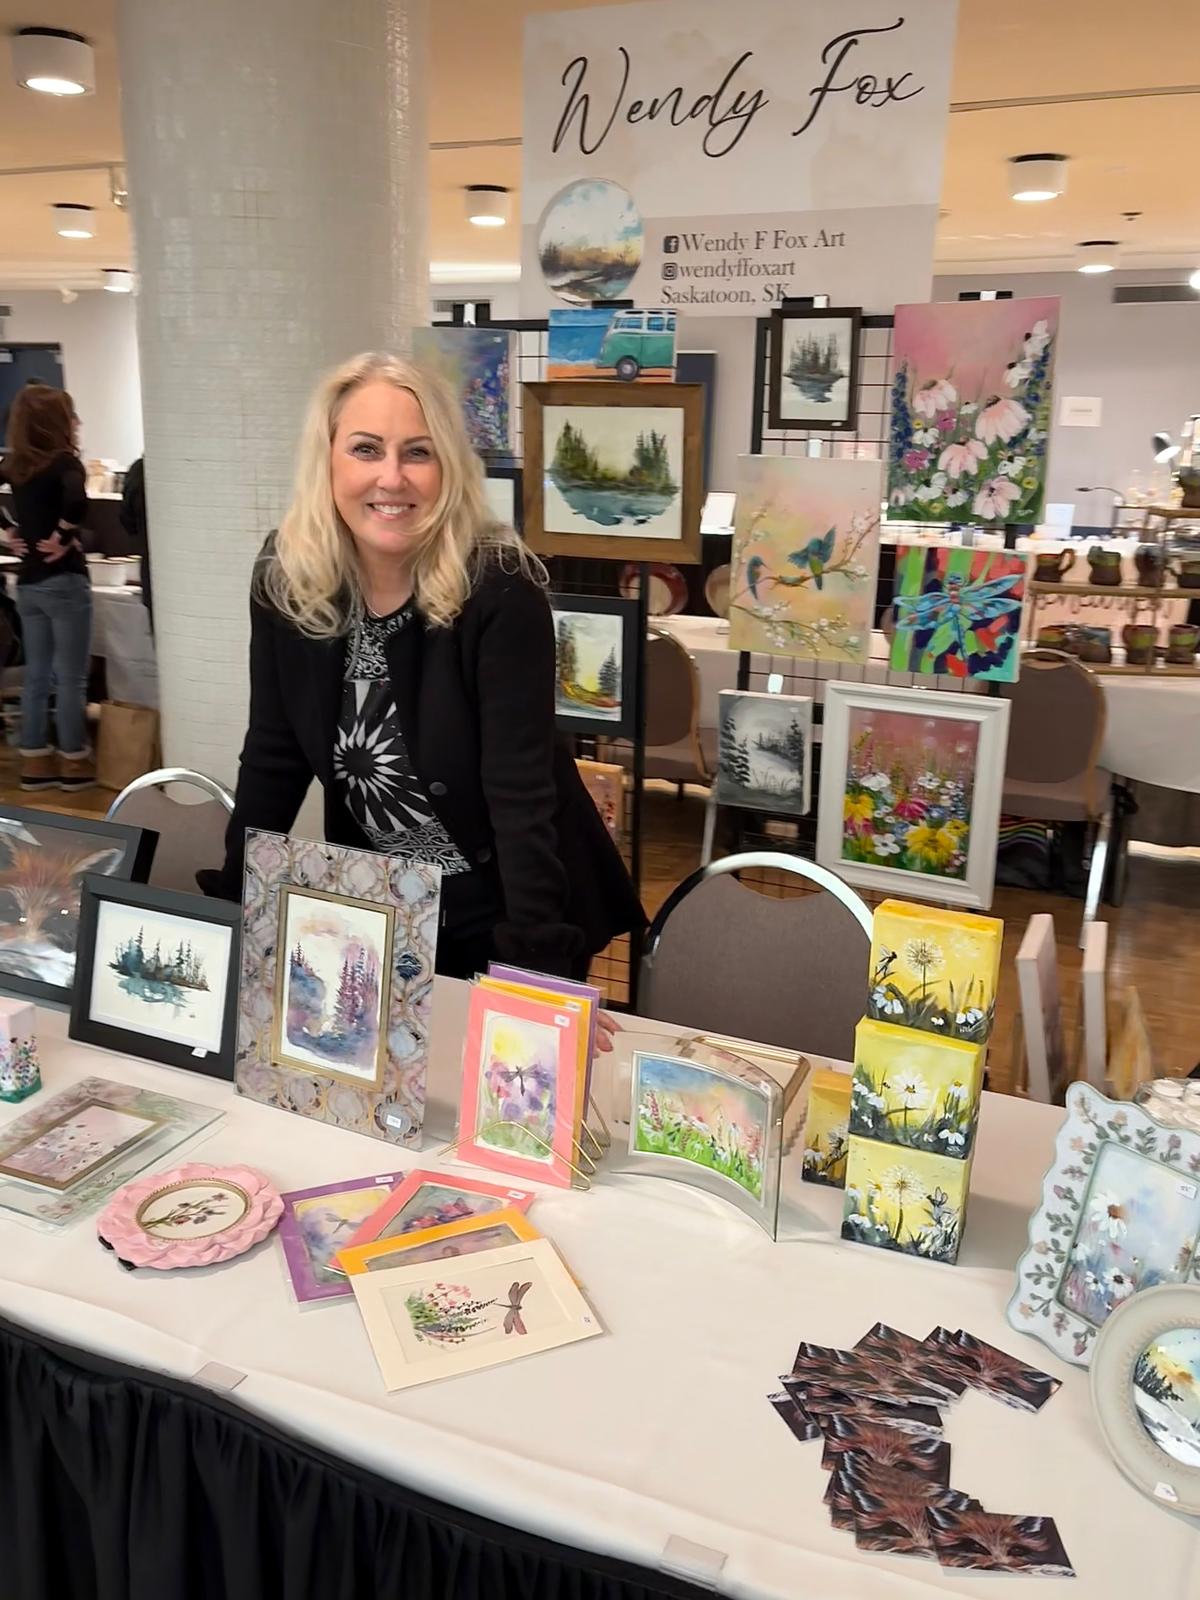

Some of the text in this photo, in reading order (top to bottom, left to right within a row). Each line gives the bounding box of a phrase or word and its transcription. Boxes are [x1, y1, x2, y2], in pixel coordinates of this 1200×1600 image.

[551, 17, 925, 158] Wendy Fox
[680, 232, 749, 254] Wendy
[754, 230, 768, 250] F
[773, 230, 808, 249] Fox
[812, 229, 847, 248] Art
[680, 257, 796, 281] wendyffoxart
[661, 283, 790, 304] Saskatoon, SK
